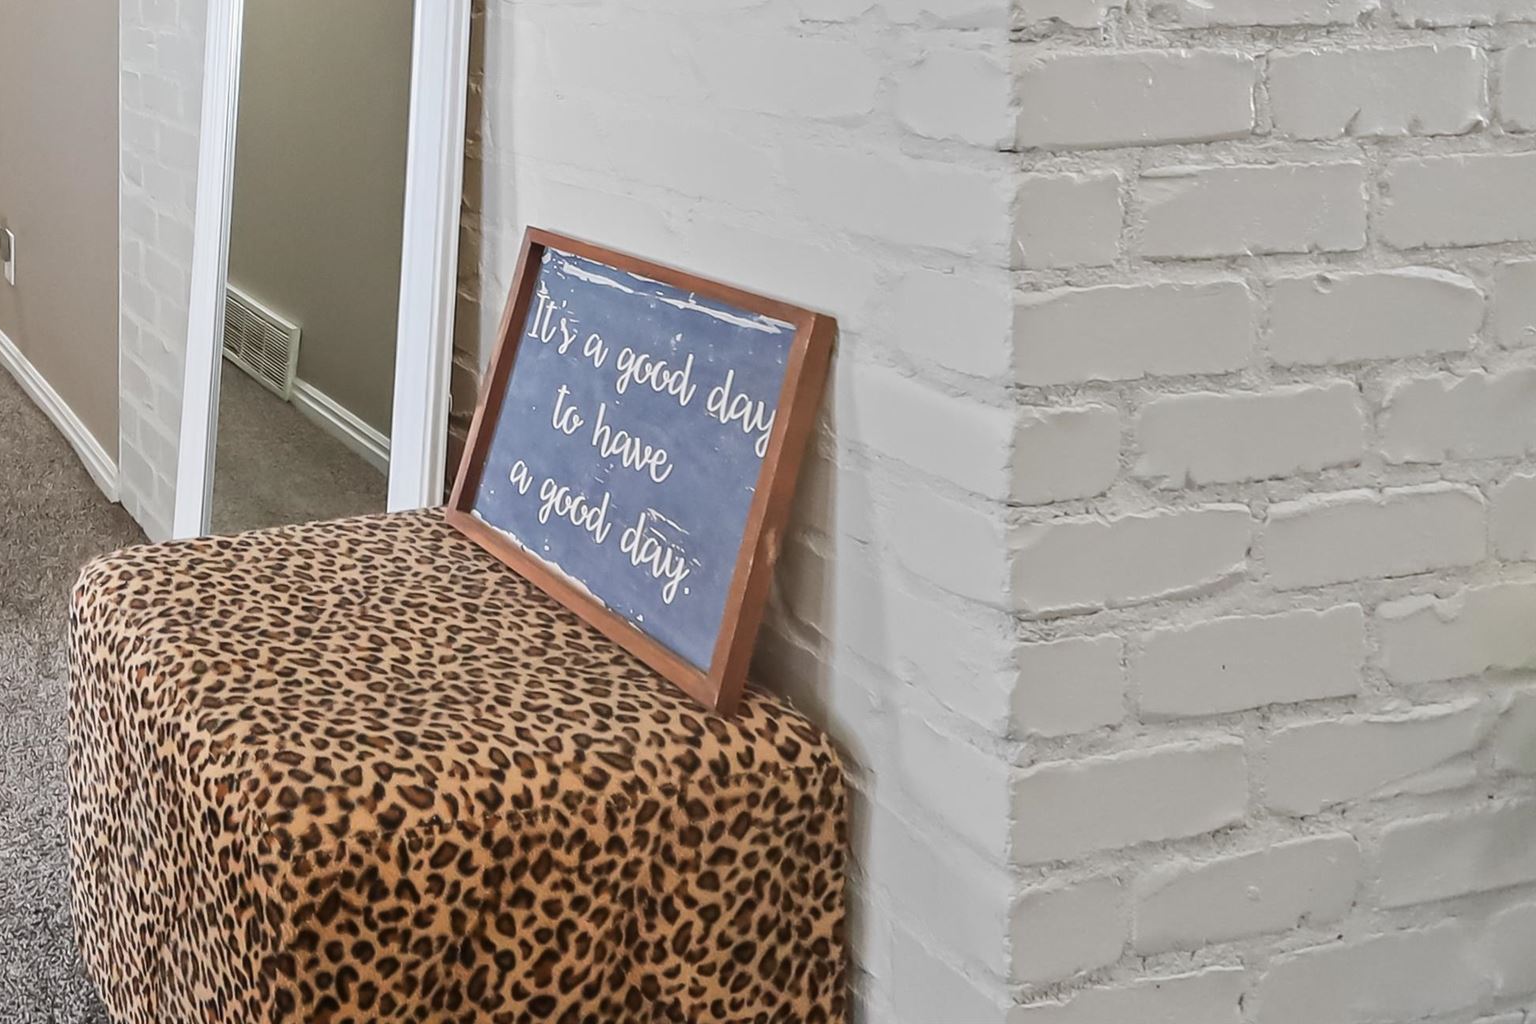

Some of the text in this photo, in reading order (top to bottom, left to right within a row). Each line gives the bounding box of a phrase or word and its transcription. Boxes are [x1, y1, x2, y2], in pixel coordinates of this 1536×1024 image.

[527, 291, 777, 459] It's a good day
[552, 384, 674, 483] to have
[509, 460, 691, 605] a good day.
